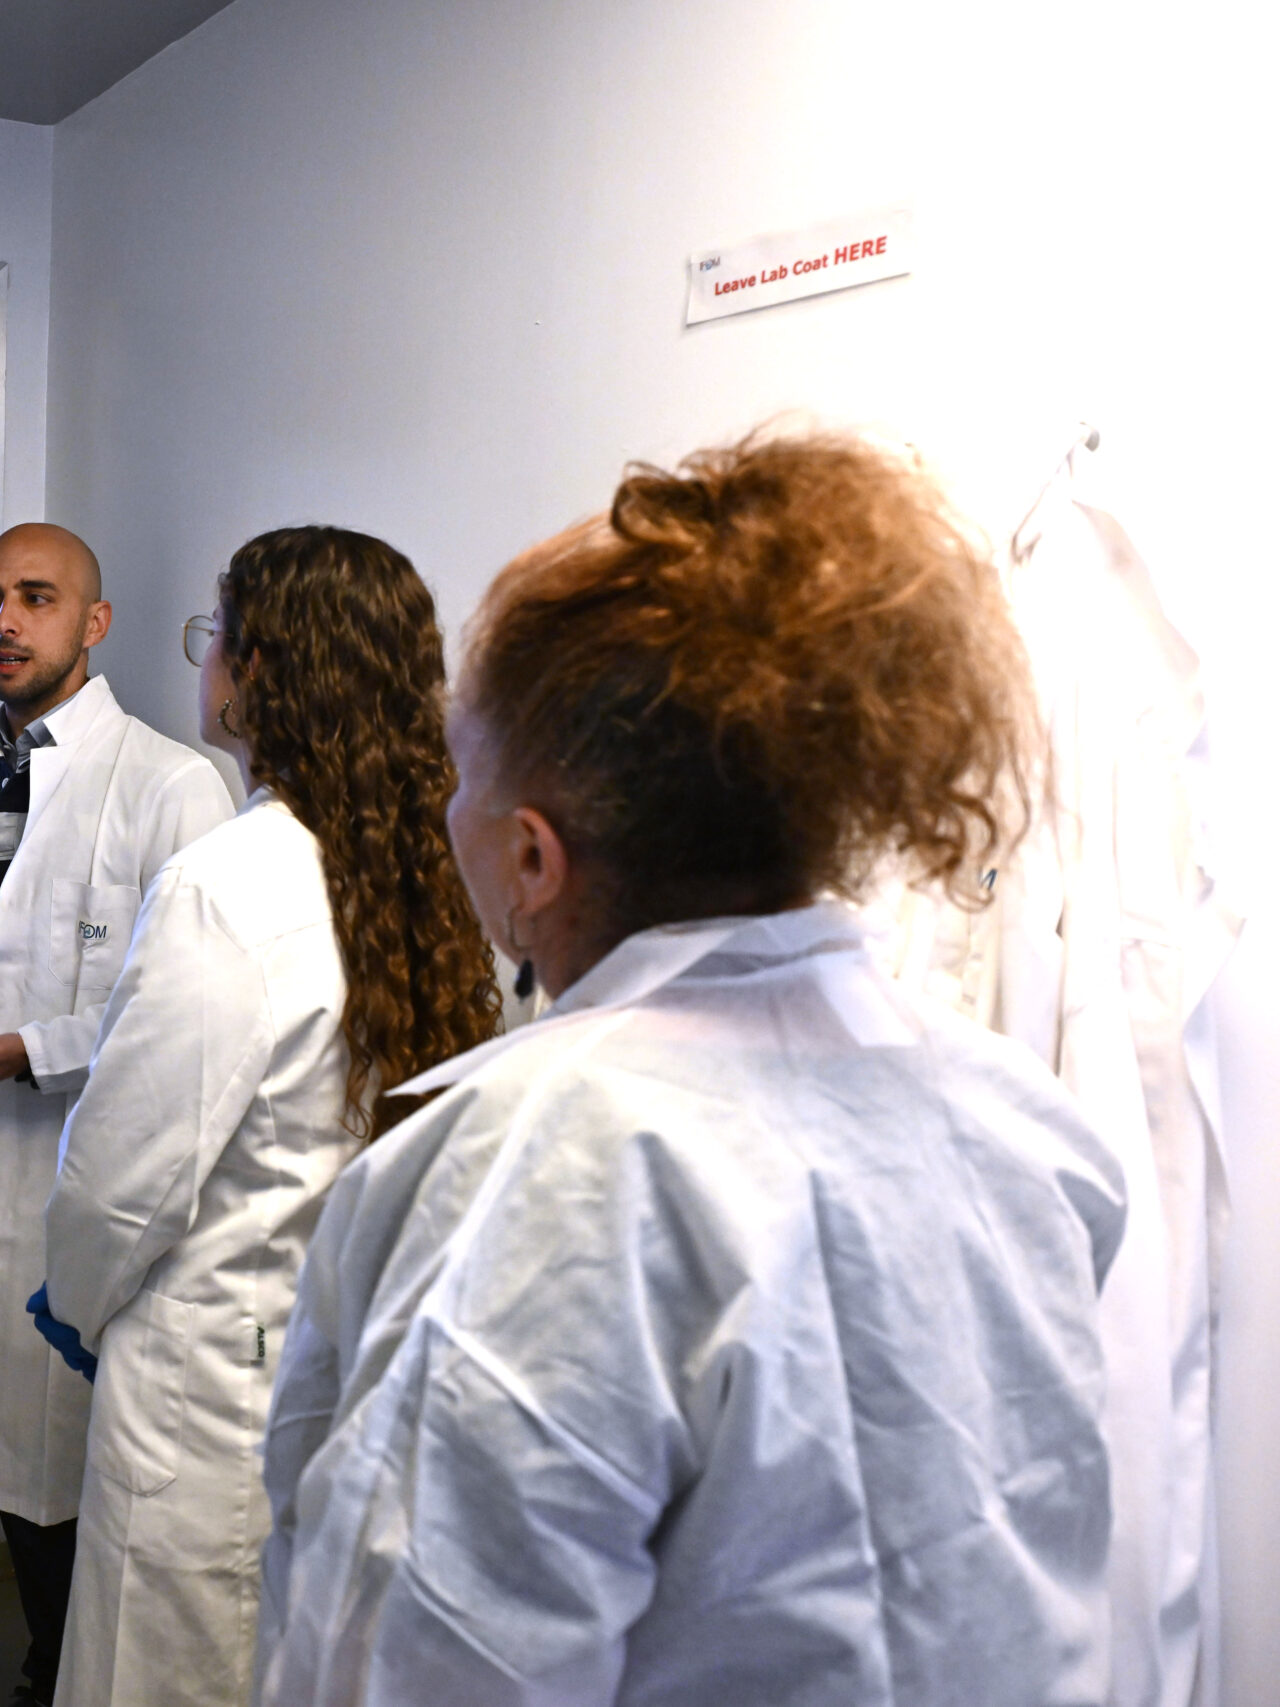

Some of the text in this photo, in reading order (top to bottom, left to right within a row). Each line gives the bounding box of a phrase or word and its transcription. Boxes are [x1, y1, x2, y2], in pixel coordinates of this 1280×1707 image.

[713, 235, 888, 296] Leave Lab Coat HERE
